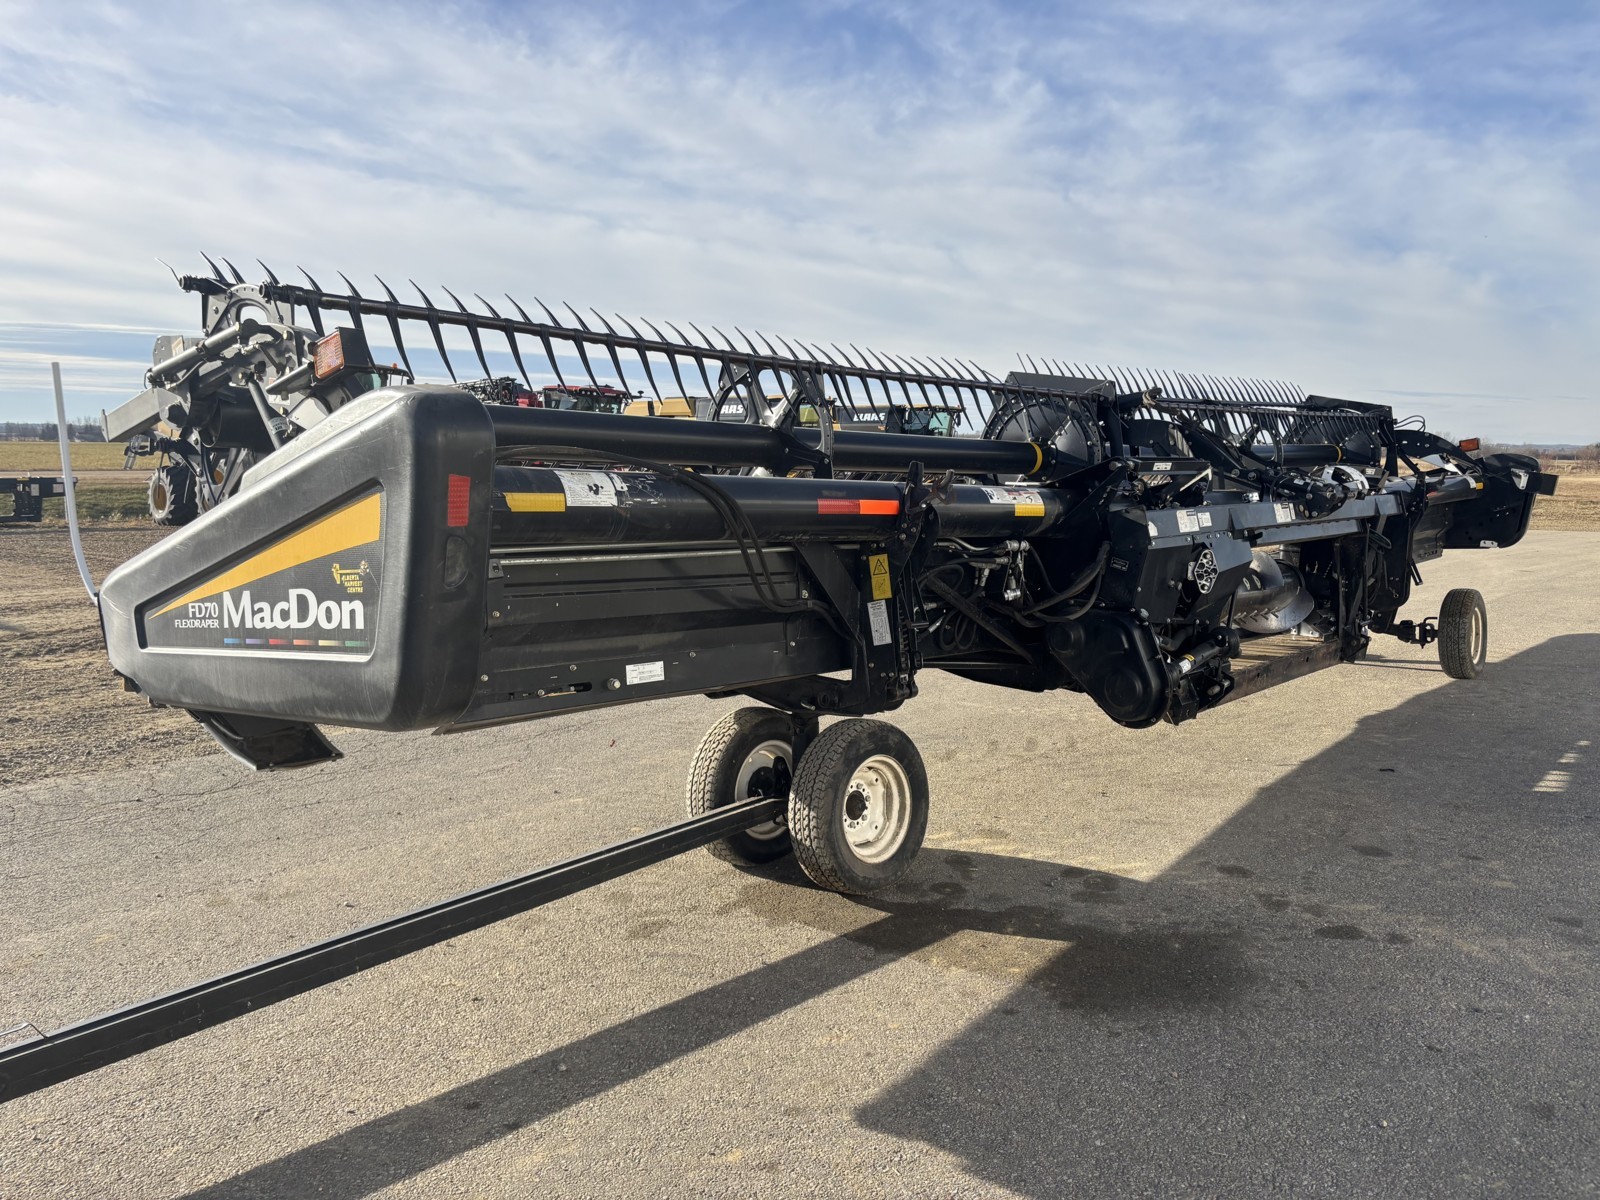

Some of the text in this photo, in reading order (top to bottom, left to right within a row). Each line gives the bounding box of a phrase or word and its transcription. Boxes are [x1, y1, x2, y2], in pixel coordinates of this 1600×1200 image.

[720, 404, 744, 414] AAS
[188, 602, 219, 618] FD70
[222, 588, 365, 630] MacDon
[174, 619, 220, 629] FLEXDRAPER
